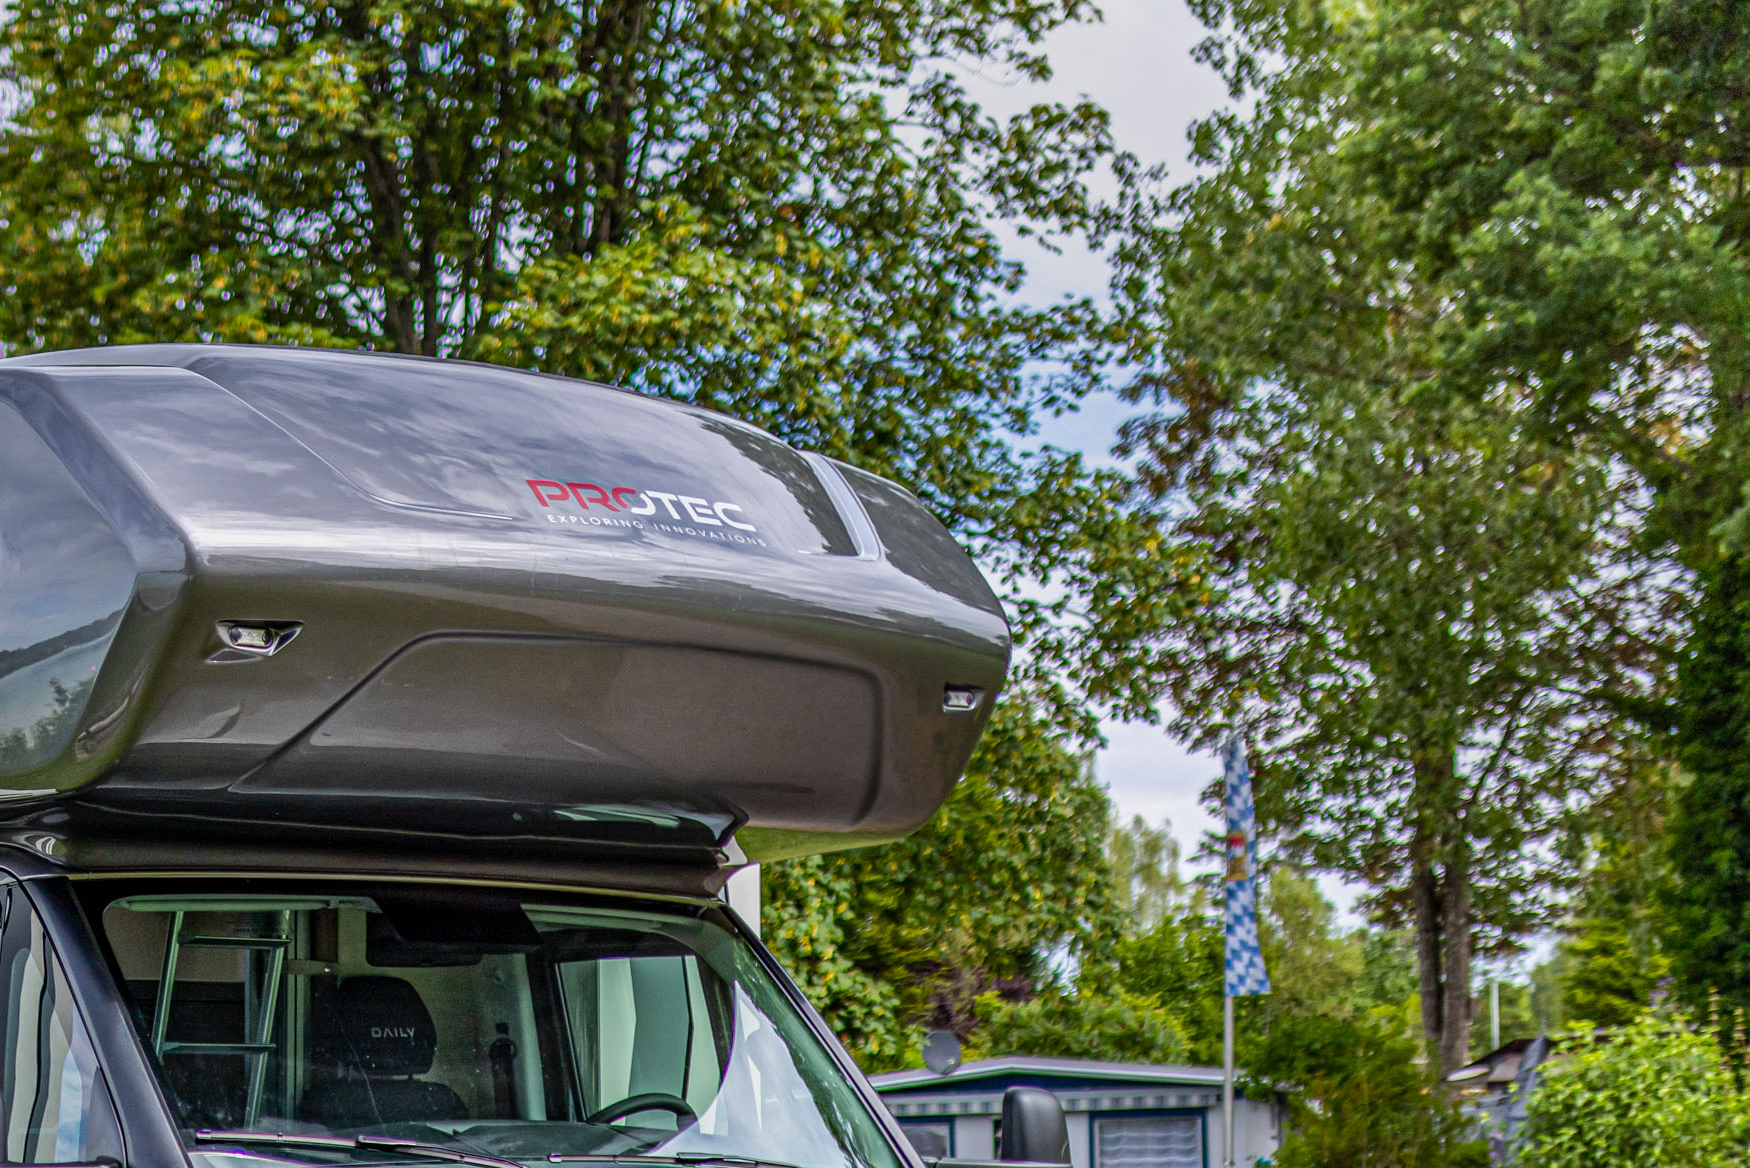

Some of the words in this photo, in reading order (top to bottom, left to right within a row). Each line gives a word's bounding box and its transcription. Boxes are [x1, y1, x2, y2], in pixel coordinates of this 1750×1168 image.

[525, 479, 756, 532] PROTEC
[546, 514, 644, 529] EXPLORING
[653, 522, 767, 547] INNOVATIONS
[371, 1027, 415, 1038] DAILY
